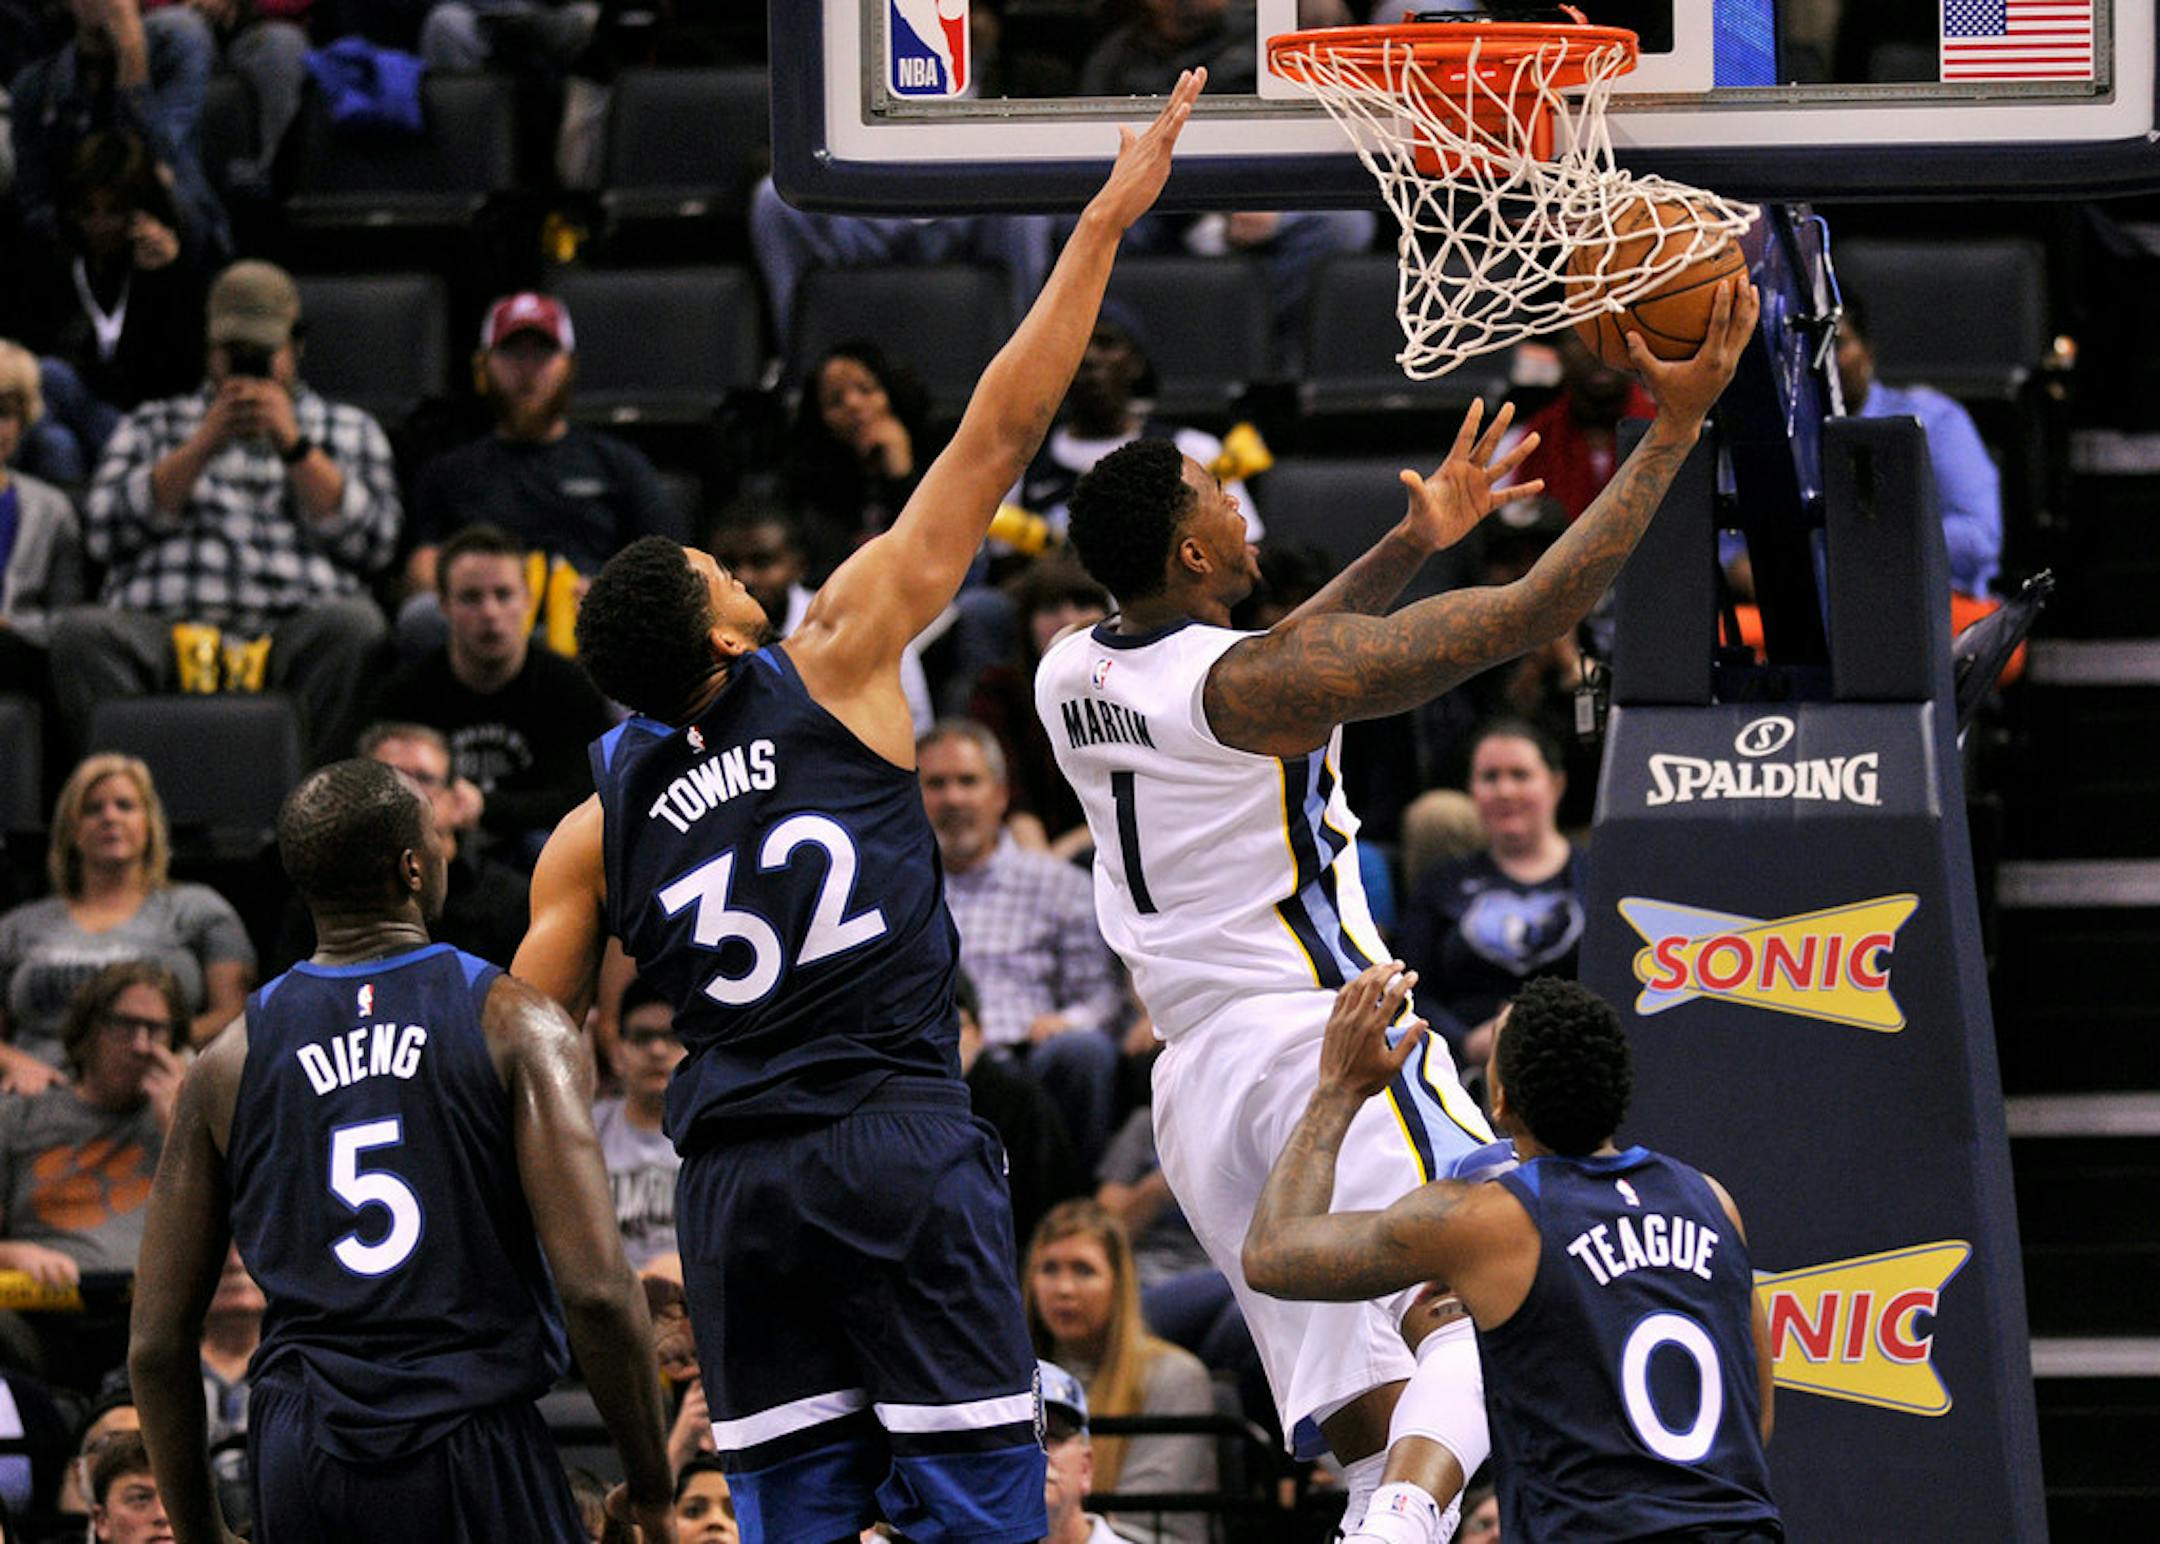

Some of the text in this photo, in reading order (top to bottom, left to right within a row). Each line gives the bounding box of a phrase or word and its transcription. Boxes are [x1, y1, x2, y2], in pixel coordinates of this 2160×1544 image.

[898, 57, 939, 88] NBA
[1062, 698, 1157, 750] MARTIN
[650, 739, 776, 833] TOWNS
[1647, 752, 1880, 806] SPALDING
[1112, 771, 1158, 914] 1
[657, 812, 887, 1007] 32
[1648, 934, 1894, 991] SONIC
[297, 1024, 427, 1096] DIENG
[329, 1117, 424, 1276] 5
[1568, 1214, 1719, 1286] TEAGUE
[1770, 1289, 1939, 1363] NIC
[1621, 1311, 1724, 1463] 0
